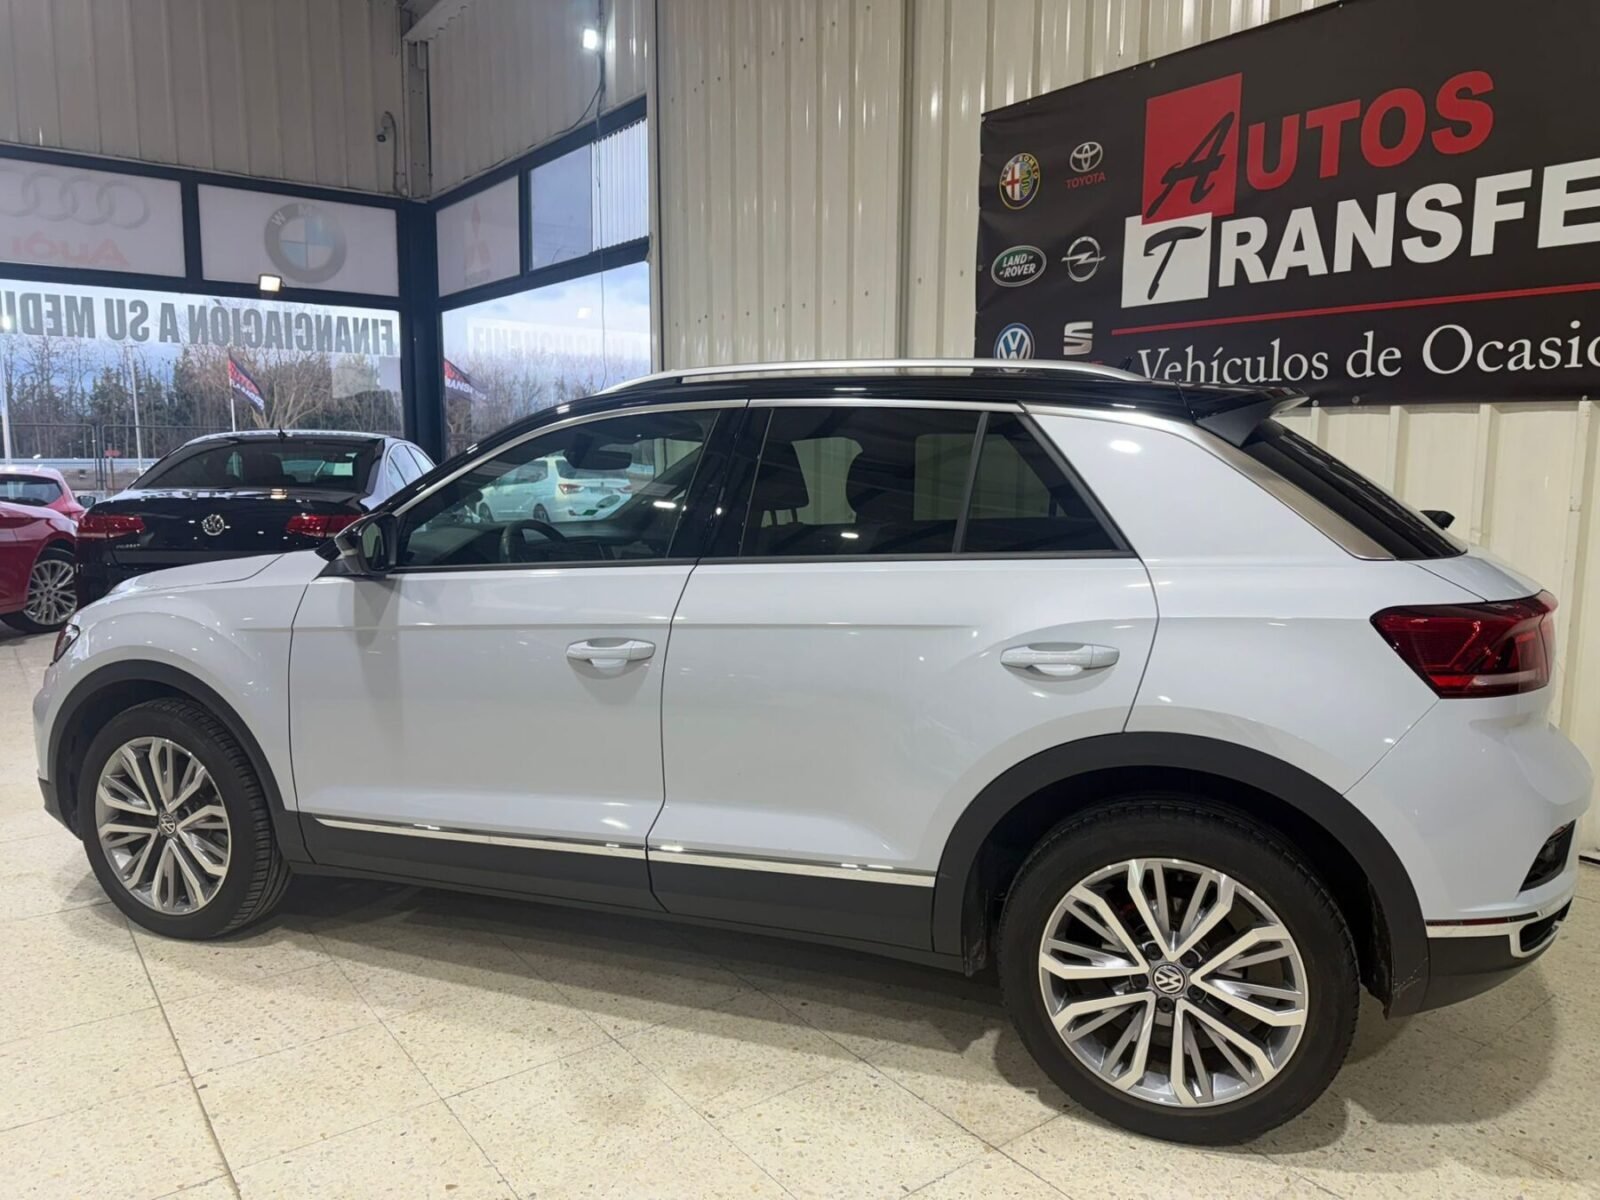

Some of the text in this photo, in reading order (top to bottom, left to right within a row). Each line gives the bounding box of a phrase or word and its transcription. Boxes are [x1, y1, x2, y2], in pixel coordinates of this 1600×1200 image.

[1065, 172, 1106, 189] TOYOTA
[1146, 70, 1494, 218] AUTOS
[1143, 158, 1600, 300] TRANSFE
[1137, 337, 1329, 385] Vehículos
[1346, 330, 1402, 379] de
